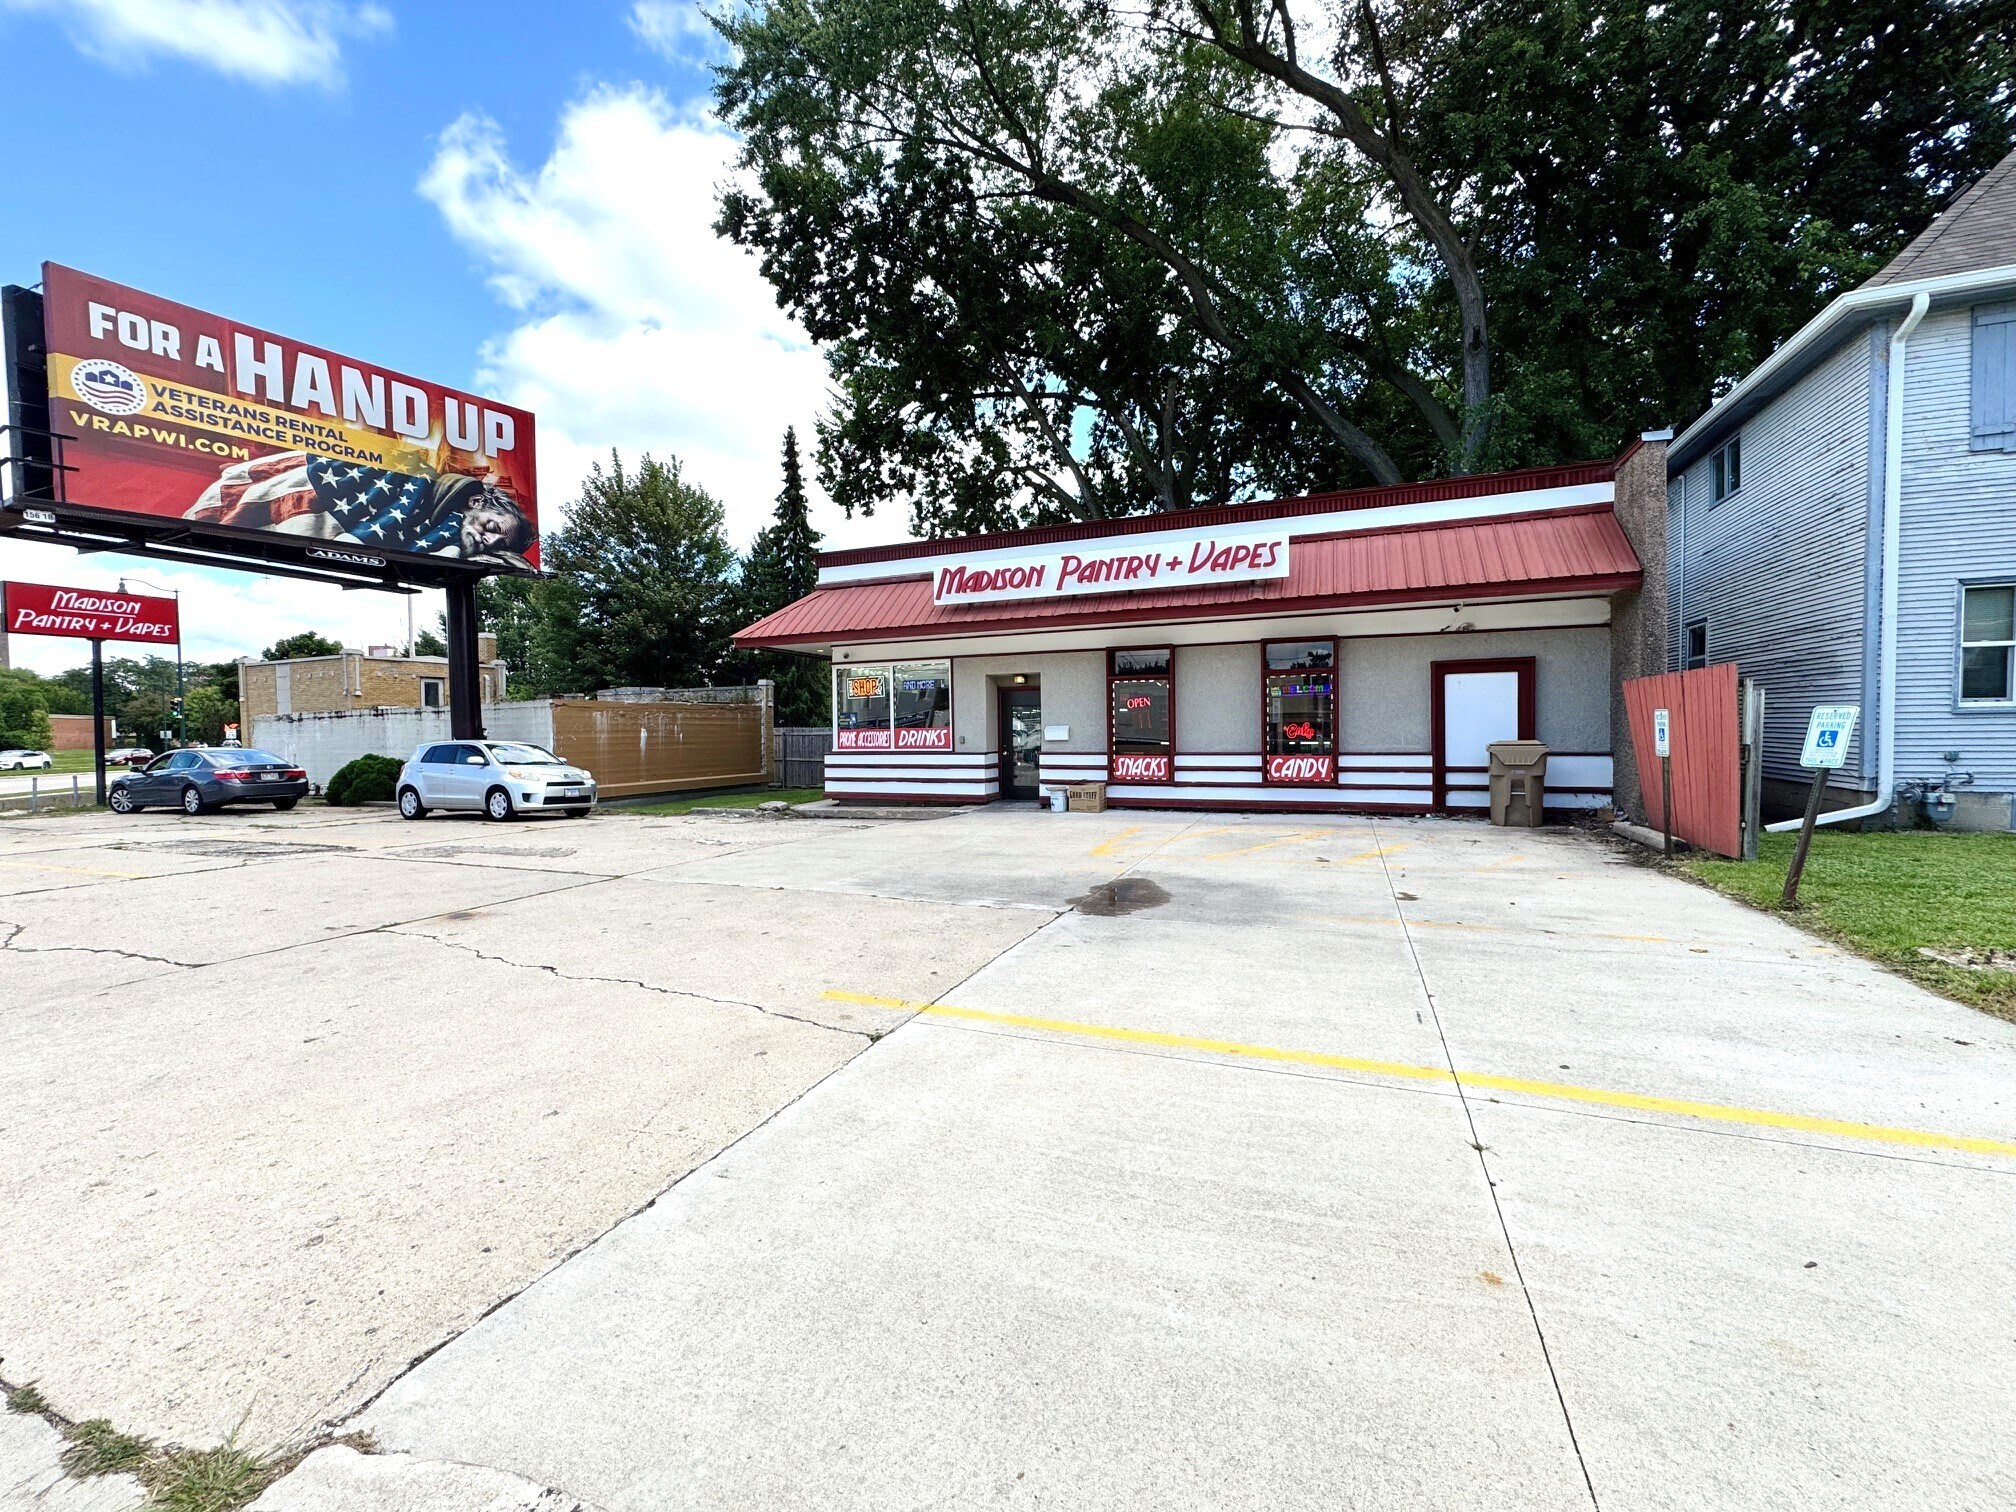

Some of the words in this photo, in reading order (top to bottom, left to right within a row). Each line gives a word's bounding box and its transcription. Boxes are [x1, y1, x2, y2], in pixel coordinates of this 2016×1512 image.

[89, 301, 181, 361] FOR
[195, 334, 225, 373] A
[234, 332, 429, 439] HAND
[444, 396, 515, 458] UP
[150, 383, 271, 424] VETERANS
[275, 415, 348, 443] RENTAL
[69, 410, 249, 461] VRAPWI.COM
[151, 401, 288, 443] ASSISTANCE
[292, 433, 383, 464] PROGRAM
[24, 511, 40, 519] 156
[312, 549, 381, 566] ADAMS
[934, 564, 1046, 600] MADISON
[1056, 553, 1161, 591] PANTRY
[1165, 555, 1183, 572] +
[1188, 540, 1282, 574] VAPES
[51, 590, 141, 614] MADISON
[14, 608, 97, 631] PANTRY
[114, 617, 172, 637] VAPES
[852, 679, 877, 696] SHOP
[1127, 697, 1151, 708] OPEN
[1816, 712, 1851, 720] RESERVED
[1816, 721, 1846, 729] PARKING
[839, 731, 856, 747] PHONE
[857, 731, 891, 747] ACCESSORIES
[898, 729, 948, 746] DRINKS
[1115, 757, 1168, 776] SNACKS
[1270, 758, 1329, 778] CANDY
